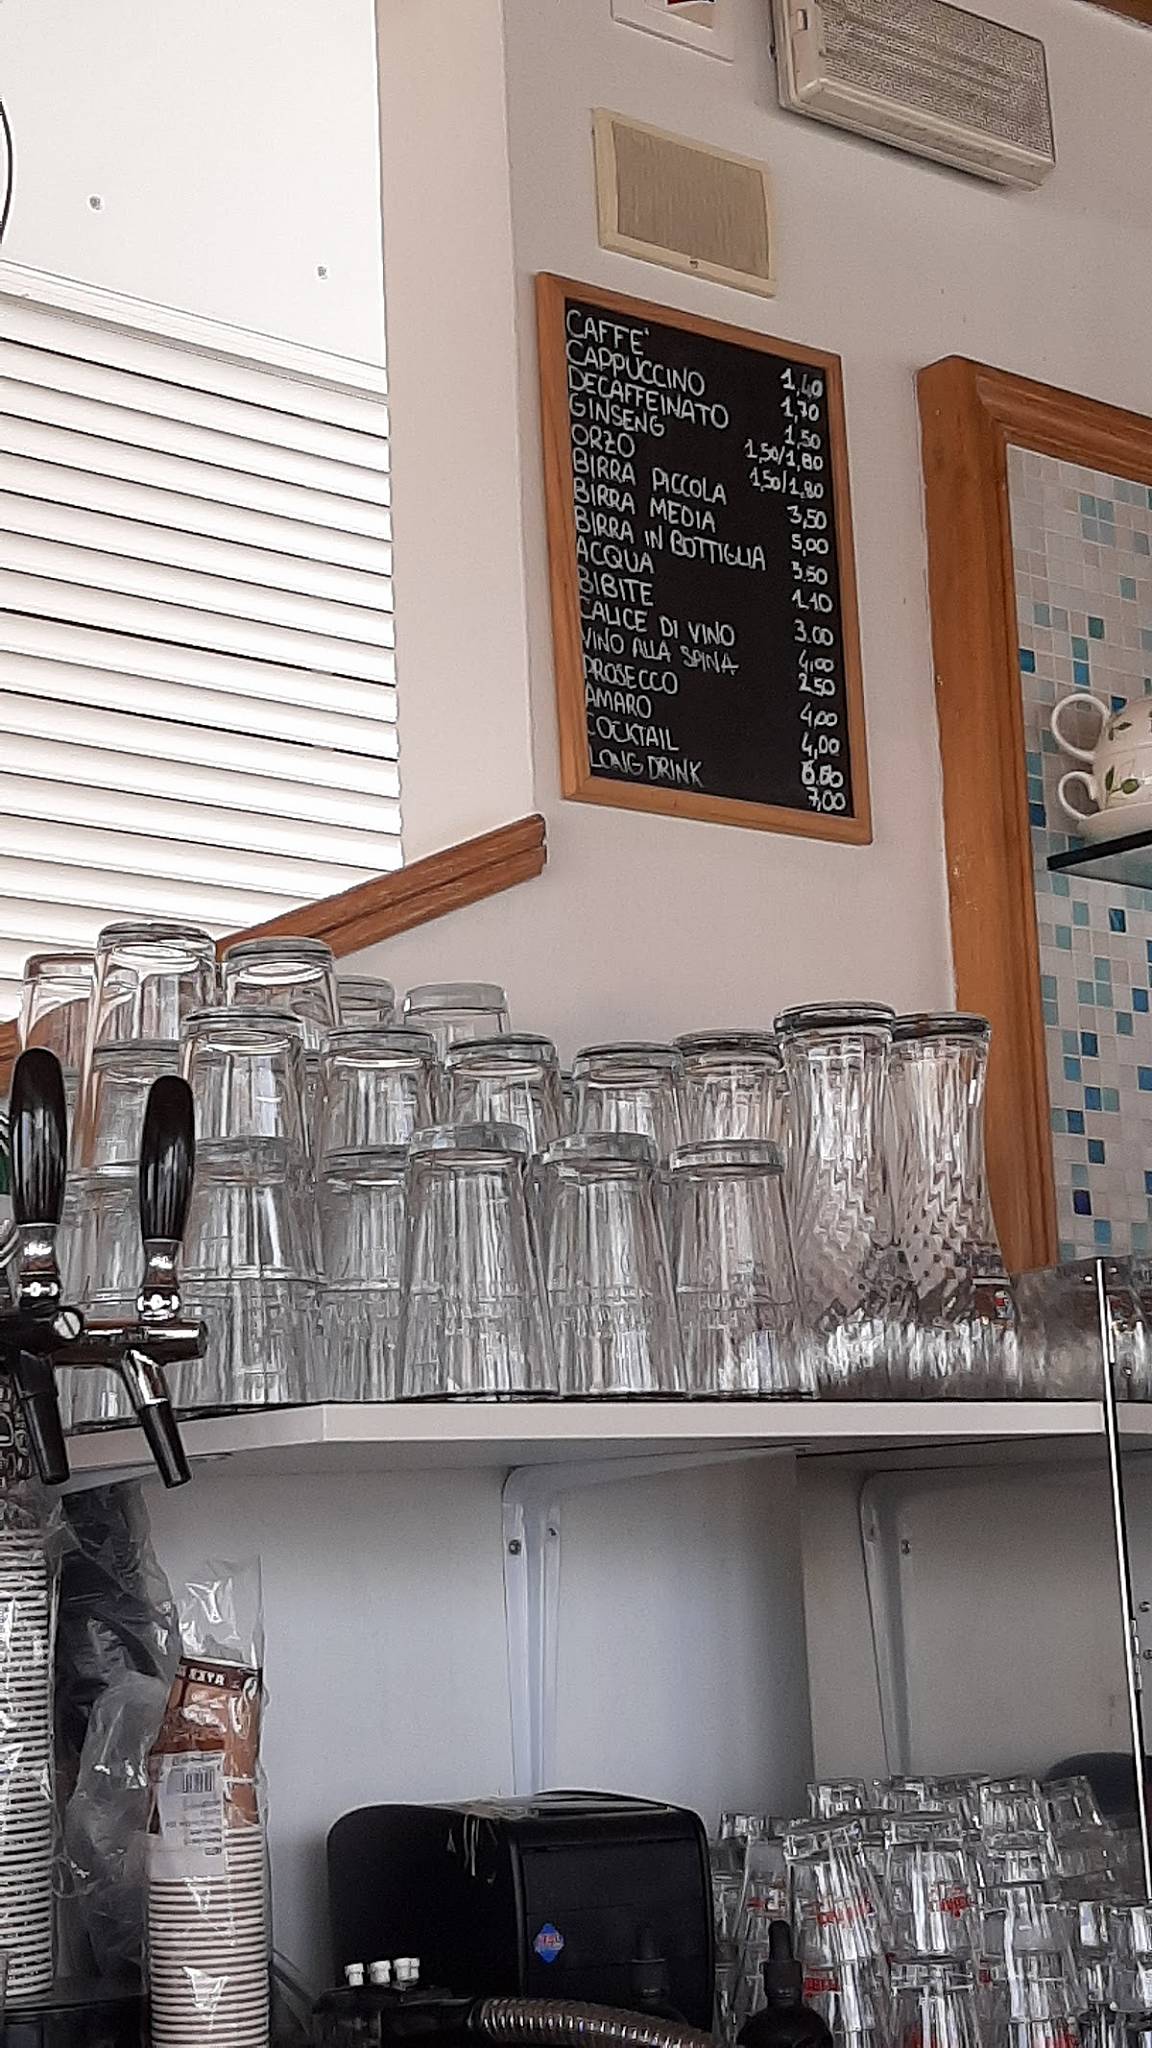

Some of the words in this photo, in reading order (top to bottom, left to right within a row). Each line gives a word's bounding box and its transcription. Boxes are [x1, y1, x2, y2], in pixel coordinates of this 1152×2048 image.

[565, 339, 705, 396] CAPPUCCINO
[568, 365, 729, 429] DECAFFEINATO
[569, 393, 665, 437] GINSENG
[571, 424, 635, 458] ORZO
[573, 448, 636, 486] BIRRA
[652, 467, 728, 505] PICCOLA
[574, 477, 635, 514] BIRRA
[650, 498, 716, 533] MEDIA
[574, 505, 634, 544] BIRRA
[644, 525, 663, 550] IN
[670, 529, 766, 571] BOTTIGLIA
[576, 535, 654, 574] ACQUA
[578, 564, 654, 607] BIBITE
[581, 626, 625, 655] VINO
[632, 636, 672, 663] ALLA
[680, 645, 740, 676] SPINA
[658, 615, 679, 640] DI
[688, 620, 736, 647] VINO
[583, 654, 678, 694] PROSECCO
[585, 681, 651, 718] AMARO
[589, 744, 644, 775] LONG
[647, 755, 704, 787] DRINK
